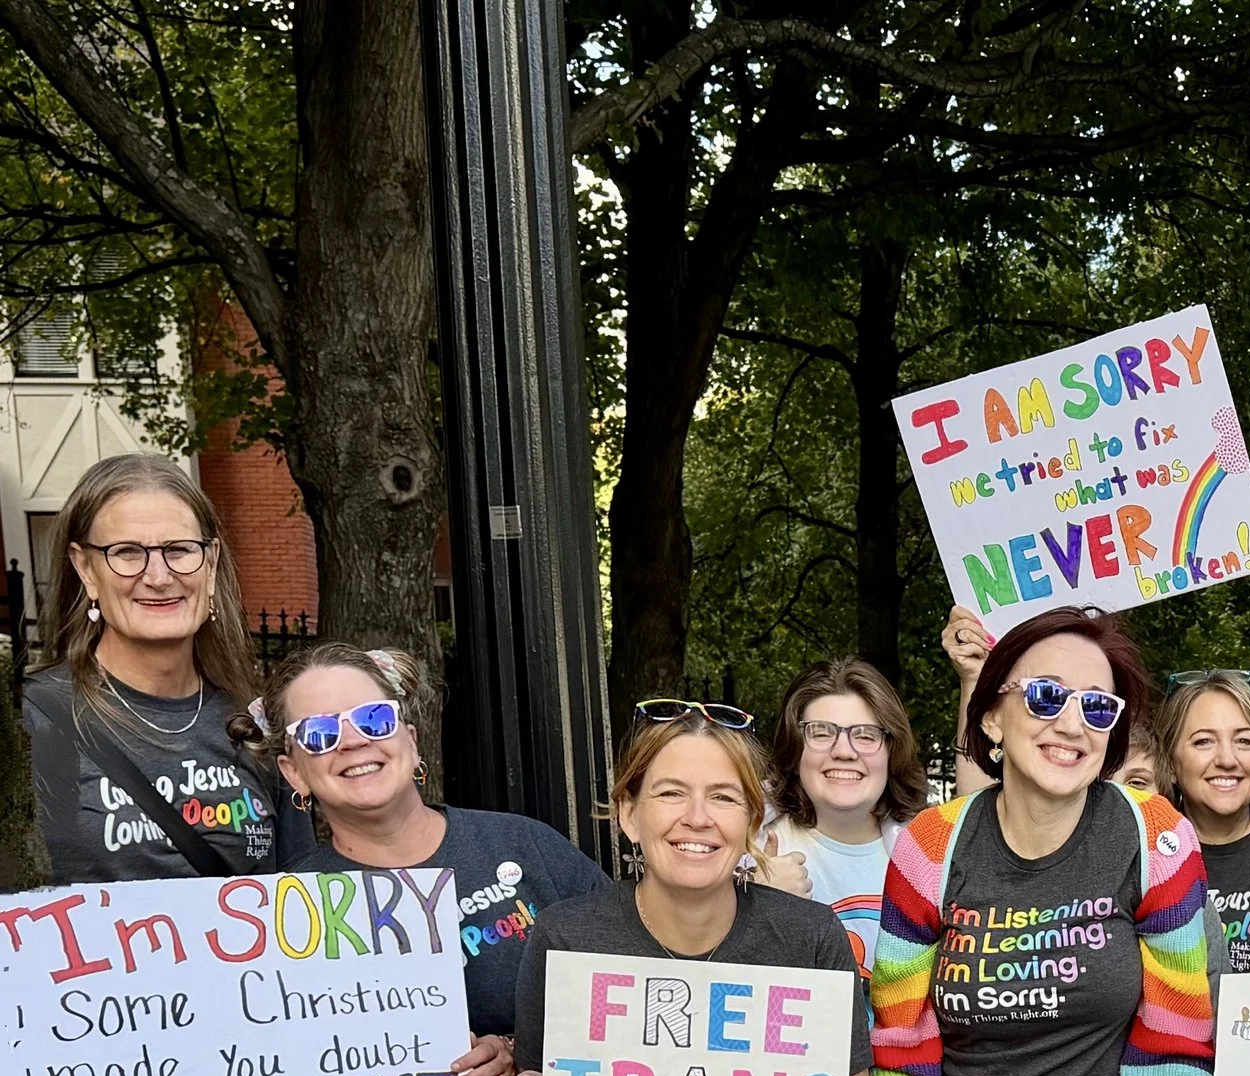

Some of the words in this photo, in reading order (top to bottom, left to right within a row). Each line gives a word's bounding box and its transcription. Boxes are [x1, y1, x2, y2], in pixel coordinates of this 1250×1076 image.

[911, 400, 969, 465] I
[983, 378, 1055, 444] AM
[1060, 327, 1210, 420] SORRY
[950, 472, 996, 508] we
[995, 438, 1081, 492] tried
[1089, 432, 1123, 463] to
[1134, 417, 1179, 451] fix
[1054, 466, 1128, 513] what
[1136, 459, 1190, 489] was
[962, 505, 1158, 616] NEVER
[179, 759, 241, 796] Jesus
[104, 812, 173, 852] Lovin
[246, 836, 272, 849] Things
[205, 867, 455, 963] SORRY
[457, 882, 517, 923] esus
[942, 902, 982, 929] 'm
[987, 896, 1119, 929] Listening.
[943, 927, 977, 954] I'm
[982, 922, 1113, 954] Learning.
[936, 956, 971, 983] I'm
[979, 955, 1087, 983] Loving.
[51, 989, 195, 1042] Some
[239, 969, 448, 1025] Christians
[589, 972, 812, 1056] FREE
[935, 984, 971, 1012] I'm
[977, 986, 1066, 1010] Sorry.
[319, 1031, 431, 1075] doubt
